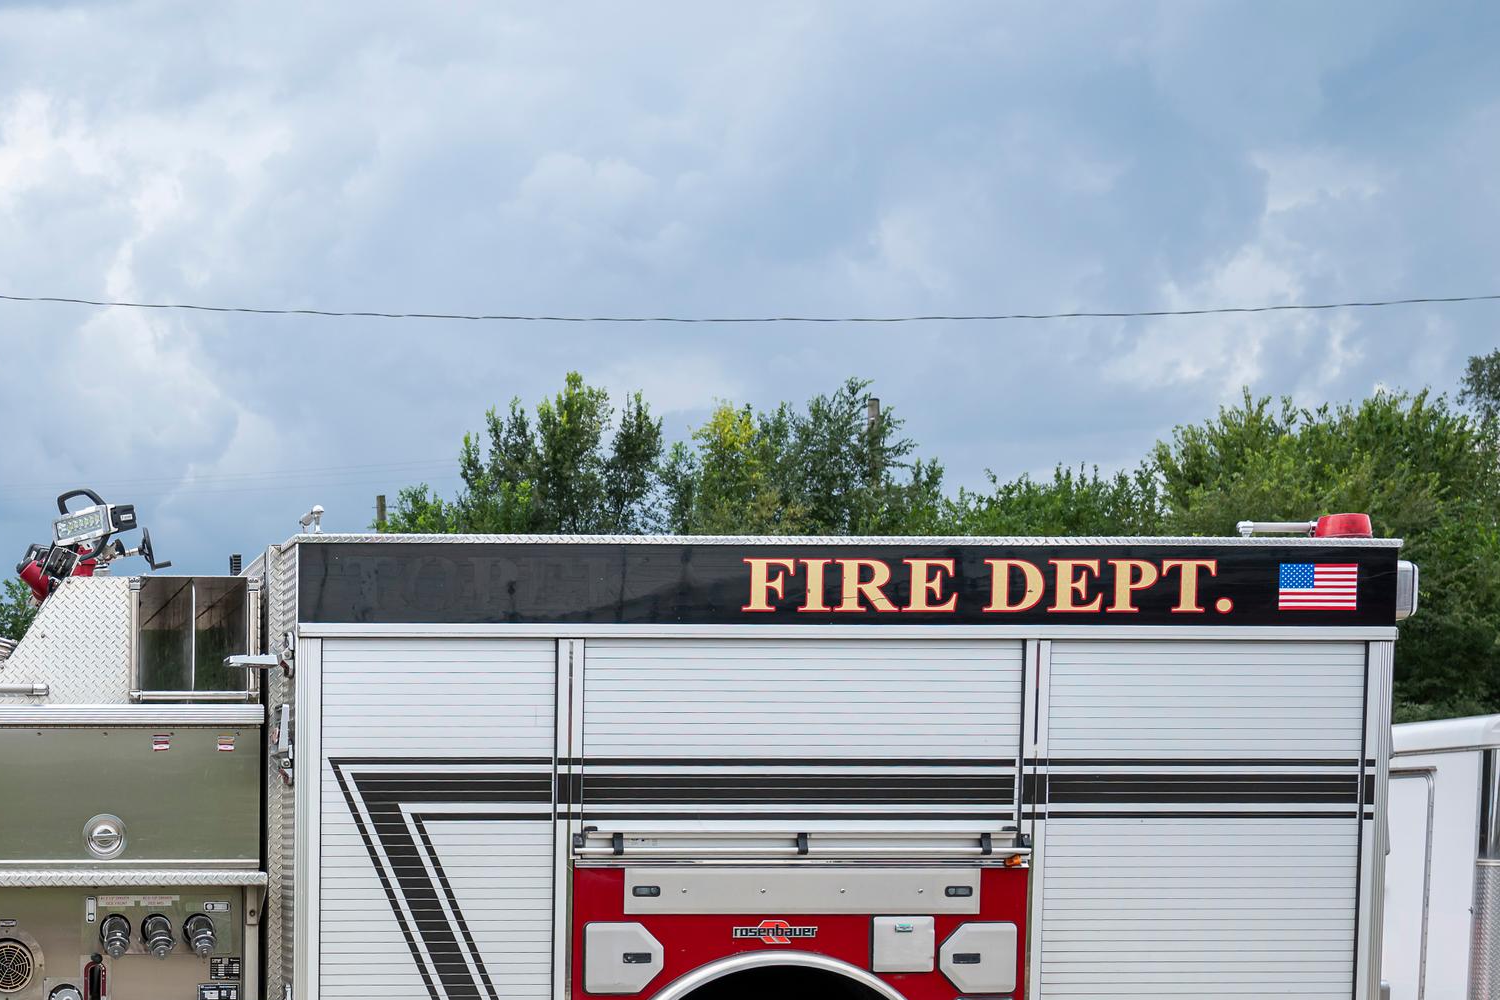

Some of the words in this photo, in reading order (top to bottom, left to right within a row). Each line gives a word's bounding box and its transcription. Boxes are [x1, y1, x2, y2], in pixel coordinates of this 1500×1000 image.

[742, 557, 958, 613] FIRE
[983, 557, 1233, 614] DEPT.
[734, 924, 818, 937] rosenbauer
